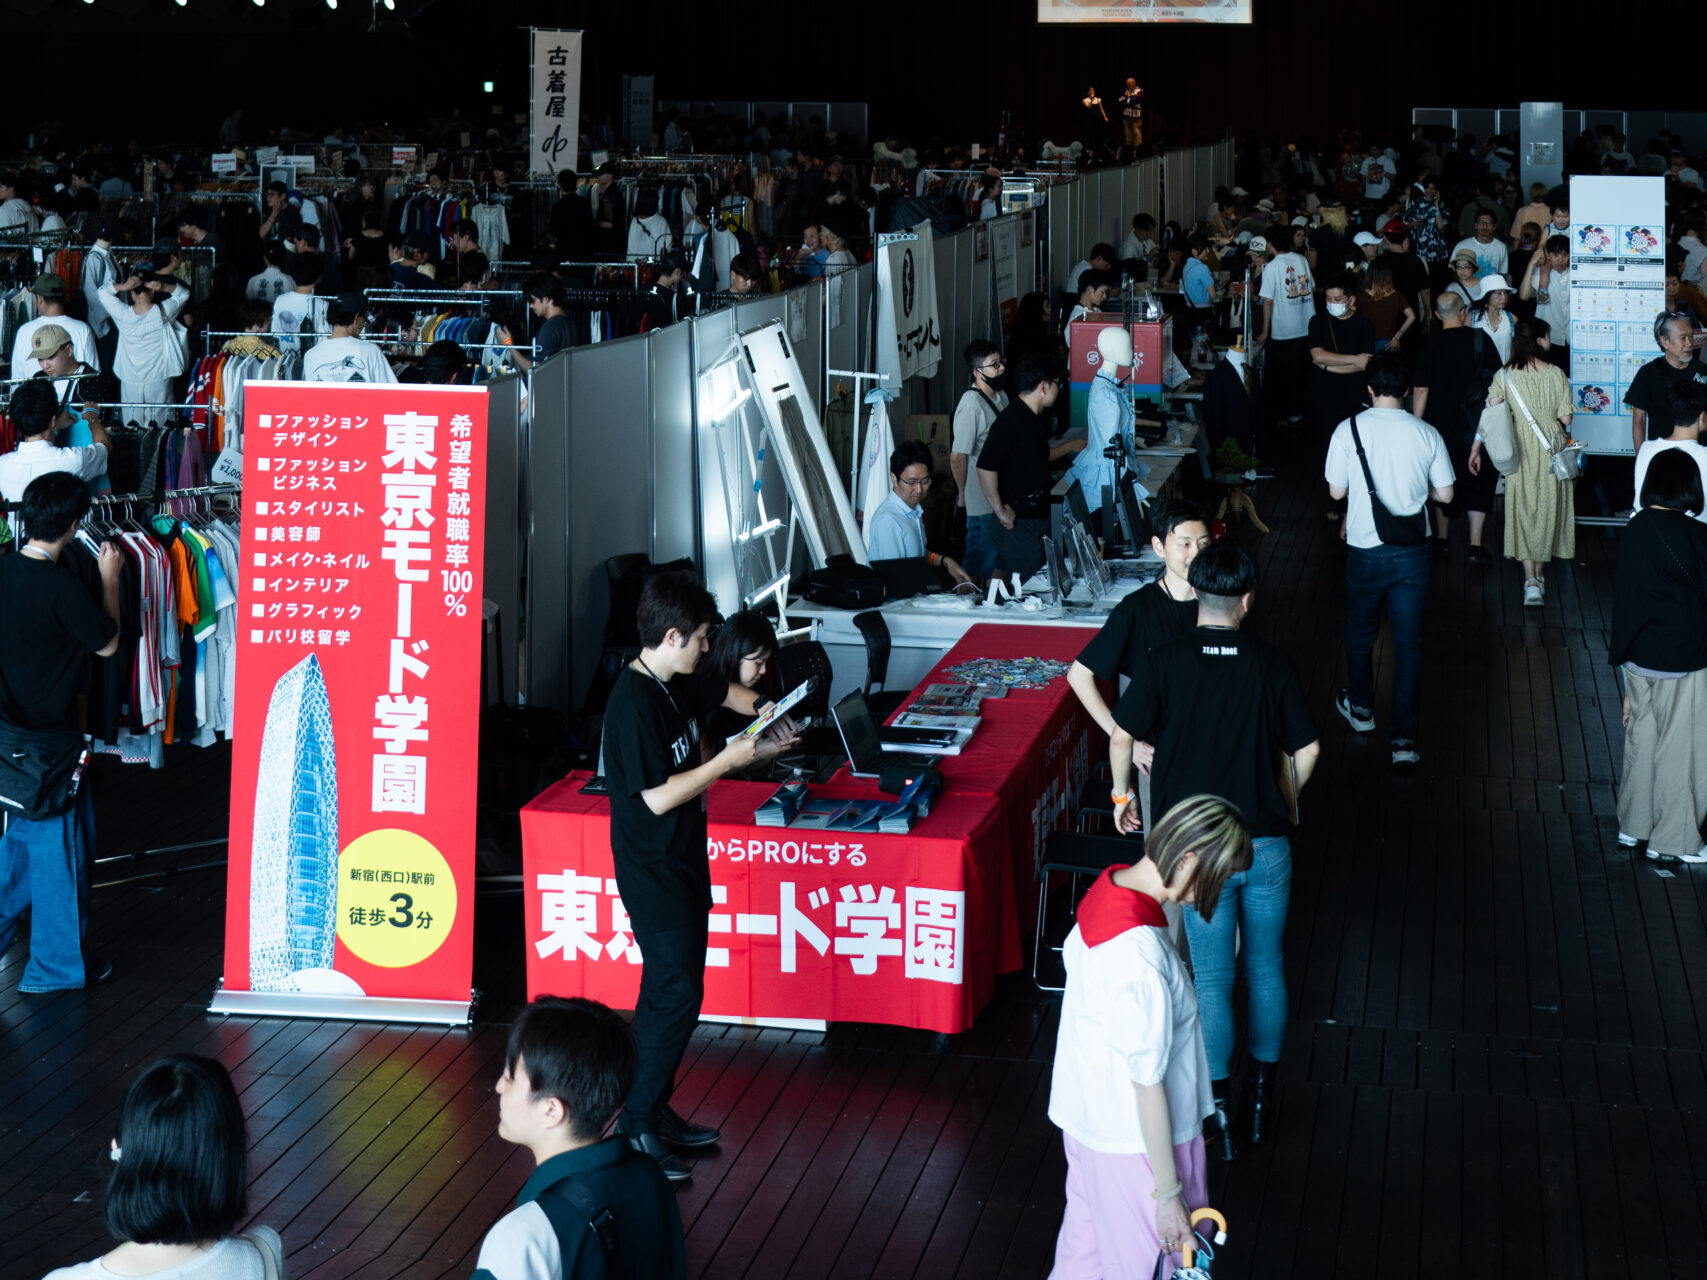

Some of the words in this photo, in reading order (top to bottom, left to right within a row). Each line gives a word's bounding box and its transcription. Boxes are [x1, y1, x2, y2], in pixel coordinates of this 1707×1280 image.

[545, 45, 569, 118] 古着屋
[275, 414, 369, 430] ファッション
[273, 432, 338, 447] デザイン
[273, 457, 367, 473] ファッション
[273, 475, 337, 491] ビジネス
[271, 500, 365, 517] スタイリスト
[270, 526, 321, 542] 美容師
[268, 577, 350, 593] インテリア
[268, 602, 362, 620] グラフィック
[371, 411, 439, 815] 東京モード学園
[266, 629, 351, 646] パリ校留学
[350, 868, 435, 885] 新宿(西口)駅前
[349, 892, 434, 929] 徒歩3分
